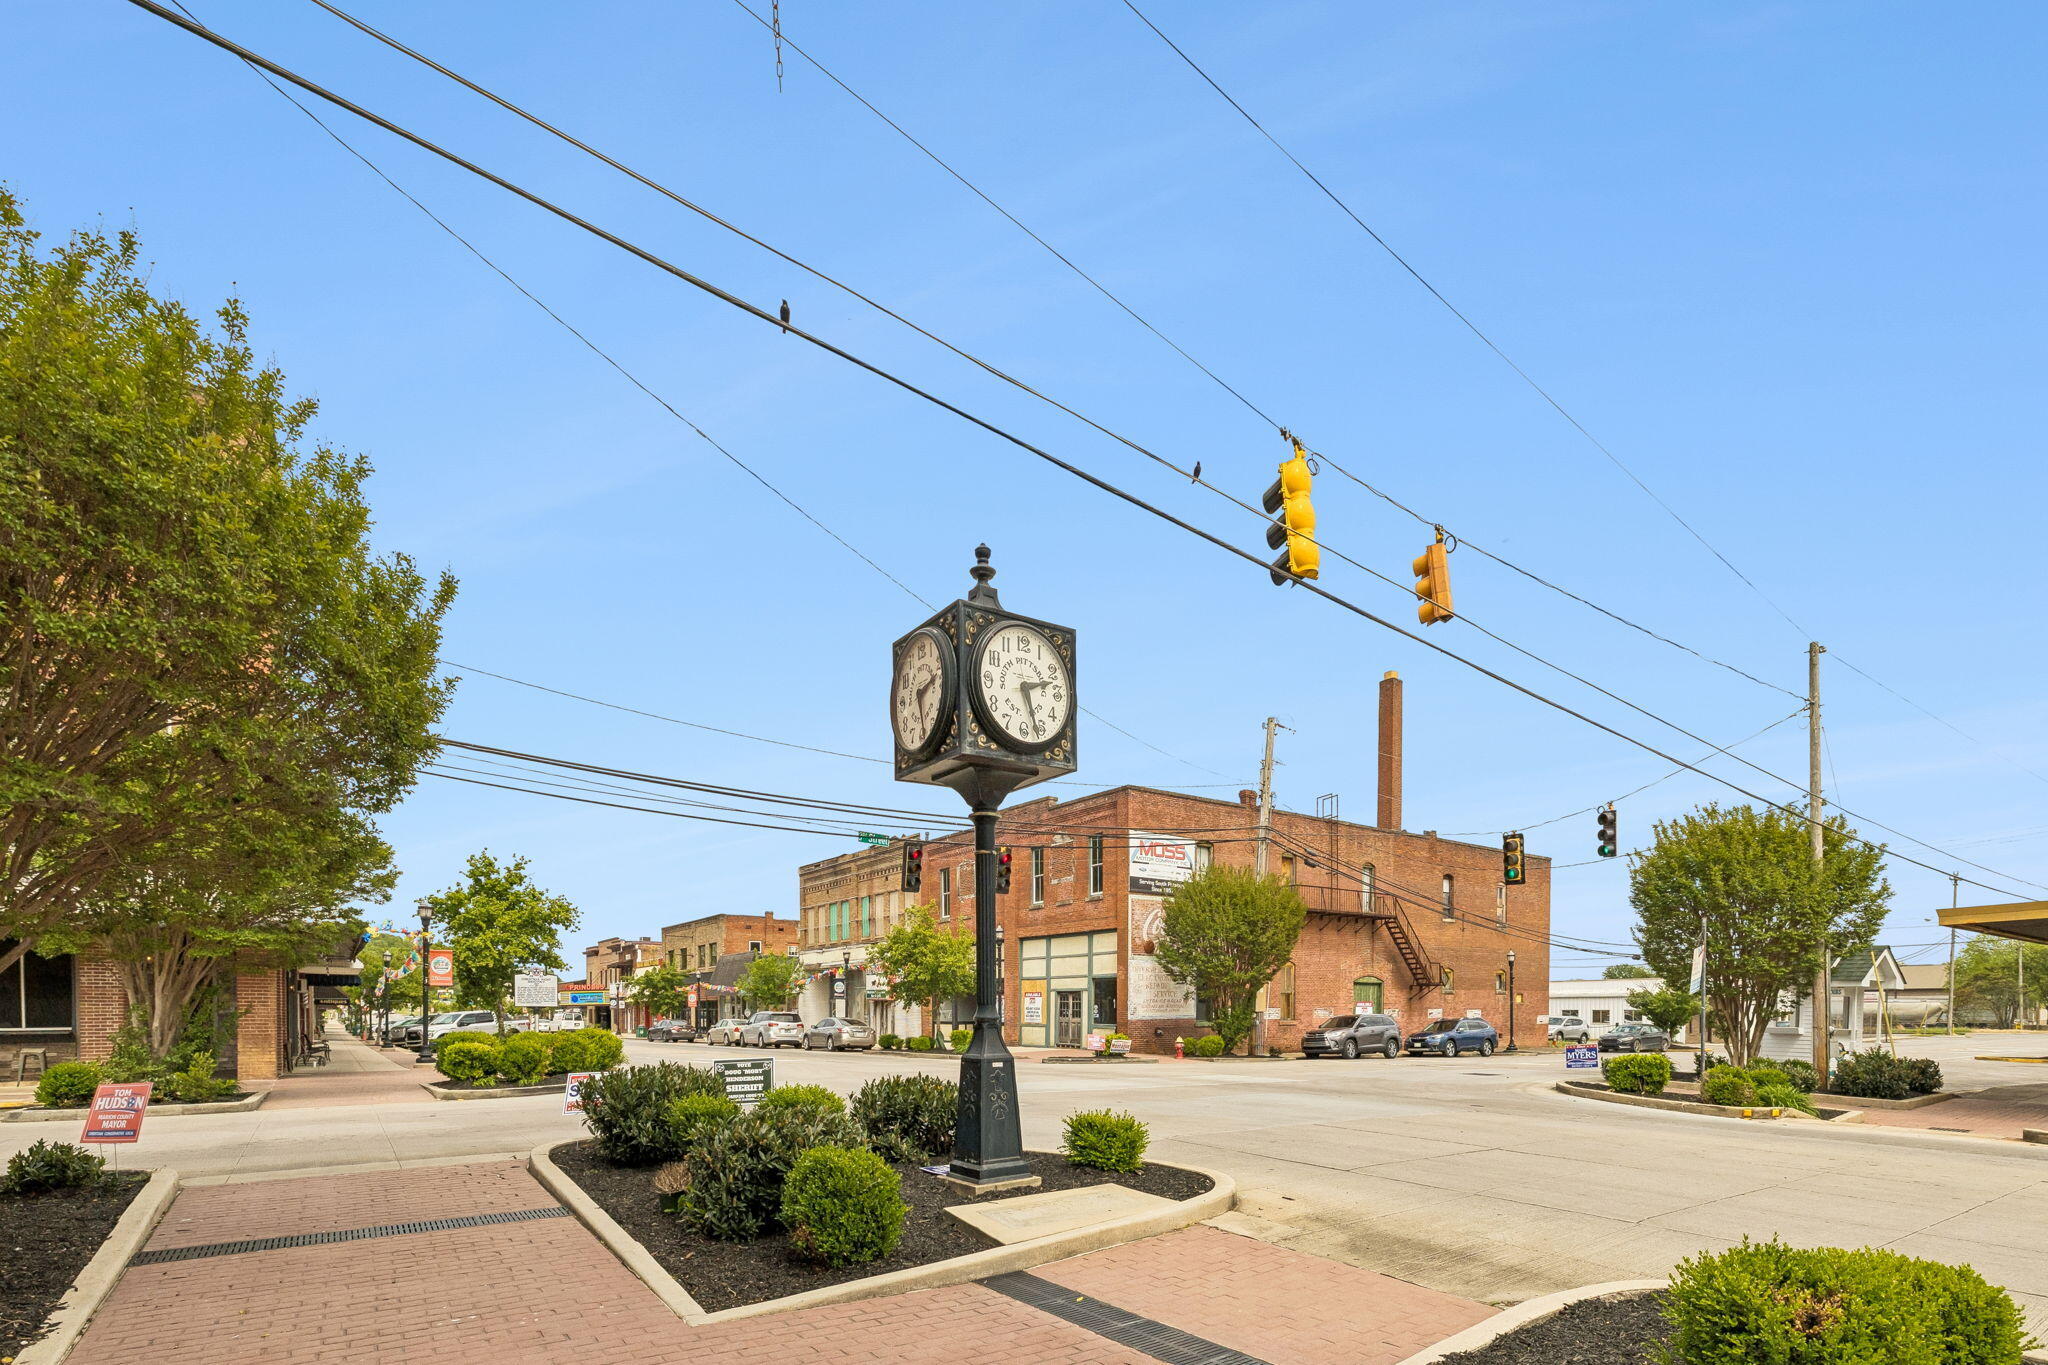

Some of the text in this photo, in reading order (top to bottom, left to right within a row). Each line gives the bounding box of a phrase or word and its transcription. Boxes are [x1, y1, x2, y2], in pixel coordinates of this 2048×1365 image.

[918, 641, 926, 660] 12
[1002, 636, 1010, 653] 11
[1017, 636, 1032, 653] 12
[1037, 644, 1041, 660] 1
[989, 650, 1000, 667] 10
[984, 670, 993, 688] 9
[1000, 657, 1046, 697] SOUTH PITTSBG
[1048, 664, 1058, 680] 2
[1052, 685, 1062, 702] 3
[990, 695, 998, 712] 8
[1004, 698, 1022, 716] EST.
[1002, 713, 1012, 730] 7
[1048, 706, 1058, 722] 4
[903, 716, 908, 732] 8
[1019, 722, 1029, 738] 6
[910, 728, 915, 744] 7
[1140, 840, 1185, 860] MOSS
[1568, 1051, 1596, 1059] MYERS
[726, 1084, 764, 1092] SHERIFF
[95, 1096, 145, 1110] HUDSON
[102, 1120, 127, 1128] MAYOR
